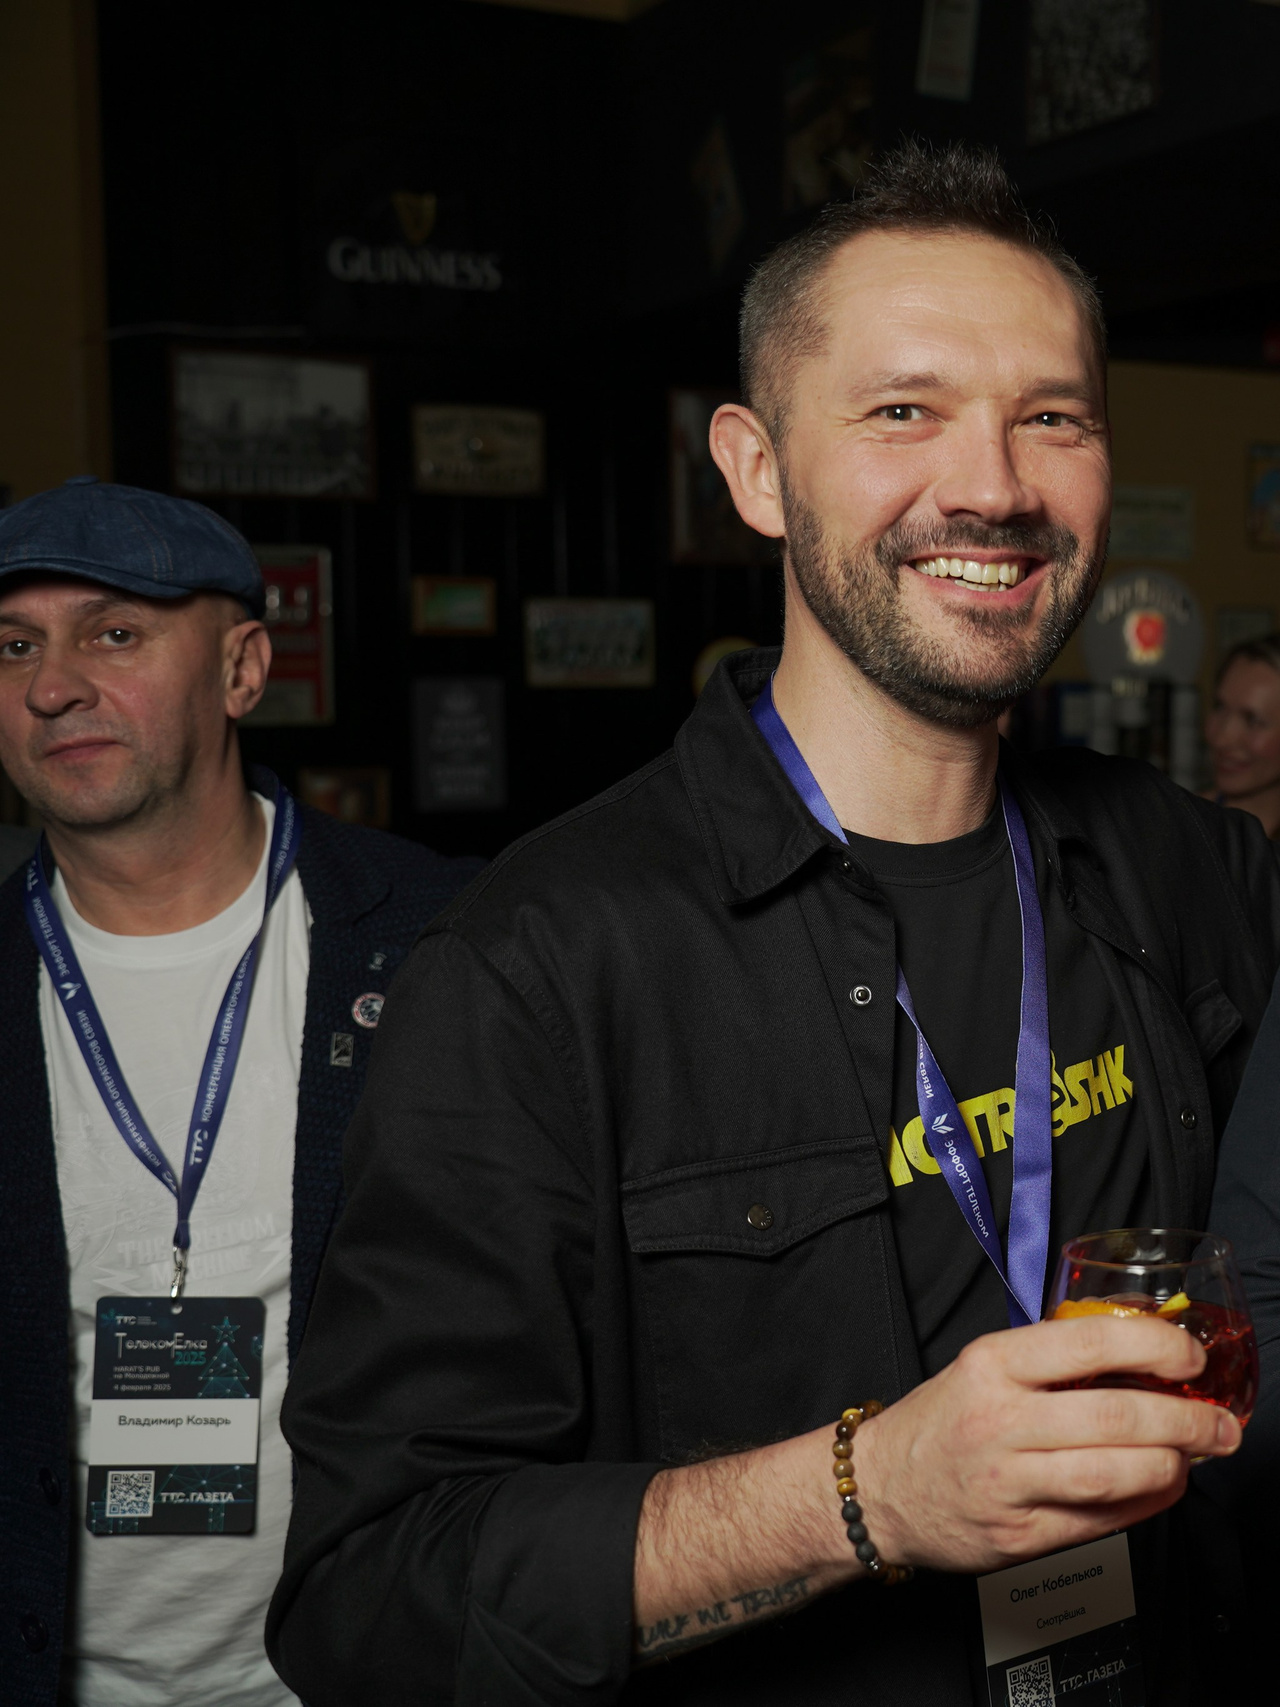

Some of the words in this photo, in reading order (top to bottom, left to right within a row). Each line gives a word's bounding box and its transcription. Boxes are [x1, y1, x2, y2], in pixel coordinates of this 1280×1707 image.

[327, 236, 503, 291] GUINNESS
[76, 1008, 97, 1041] СВЯЗИ
[87, 1038, 121, 1101] ОПЕРАТОРОВ
[201, 1046, 228, 1123] КОНФЕРЕНЦИЯ
[918, 1062, 935, 1100] СВЯЗИ
[114, 1098, 162, 1168] КОНФЕРЕНЦИЯ
[944, 1139, 972, 1187] ЭФФОРТ
[965, 1184, 990, 1240] ТЕЛЕКОМ
[174, 1350, 207, 1366] 2025
[118, 1415, 184, 1428] Владимир
[186, 1415, 232, 1428] Козарь
[1010, 1585, 1040, 1603] Олег
[1042, 1565, 1104, 1593] Кобельков
[1036, 1606, 1087, 1630] Смотрёшка
